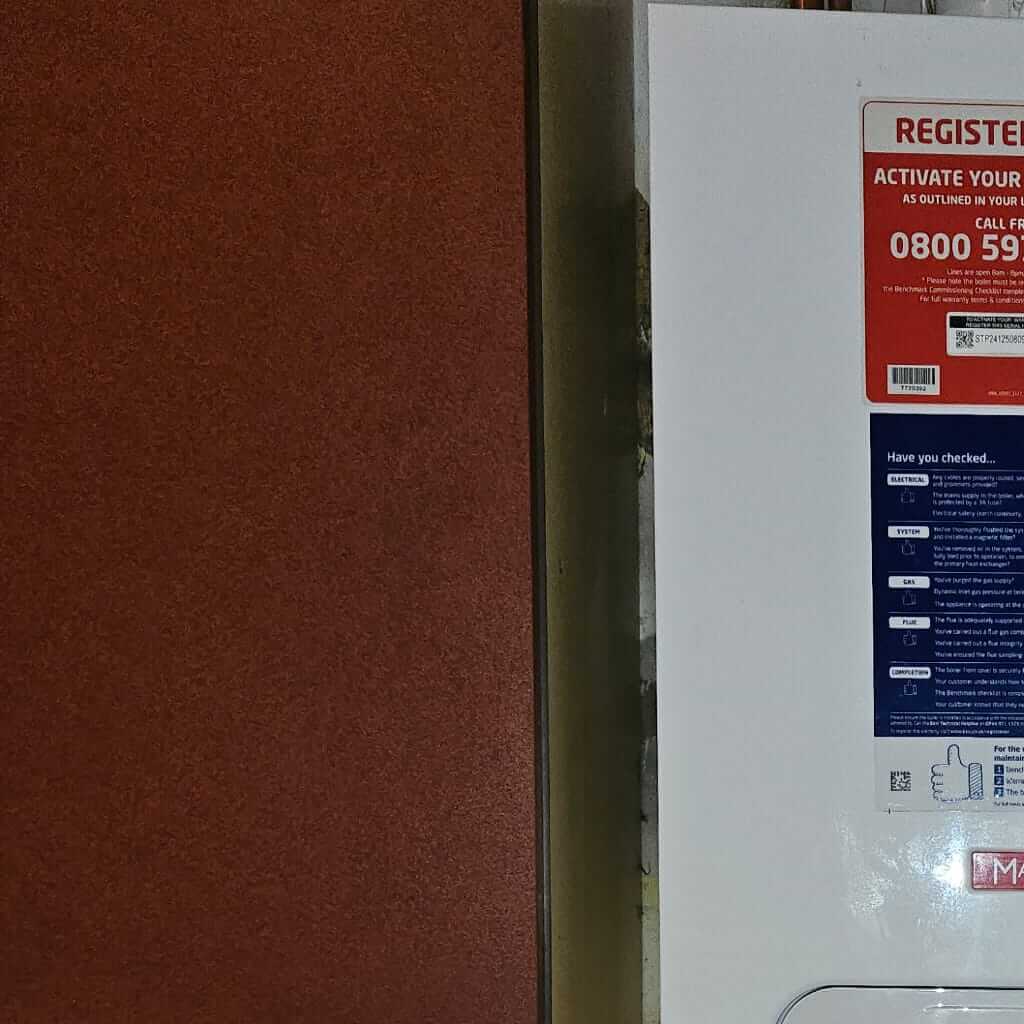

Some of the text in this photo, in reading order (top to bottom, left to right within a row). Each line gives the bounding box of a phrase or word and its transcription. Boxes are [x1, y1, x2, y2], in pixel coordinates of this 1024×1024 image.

[874, 168, 963, 187] ACTIVATE
[969, 170, 1021, 188] YOUR
[903, 194, 917, 205] AS
[919, 194, 971, 206] OUTLINED
[974, 195, 986, 206] IN
[988, 196, 1018, 207] YOUR
[975, 217, 1006, 230] CALL
[890, 231, 971, 261] 0800
[887, 451, 915, 463] Have
[918, 454, 938, 465] you
